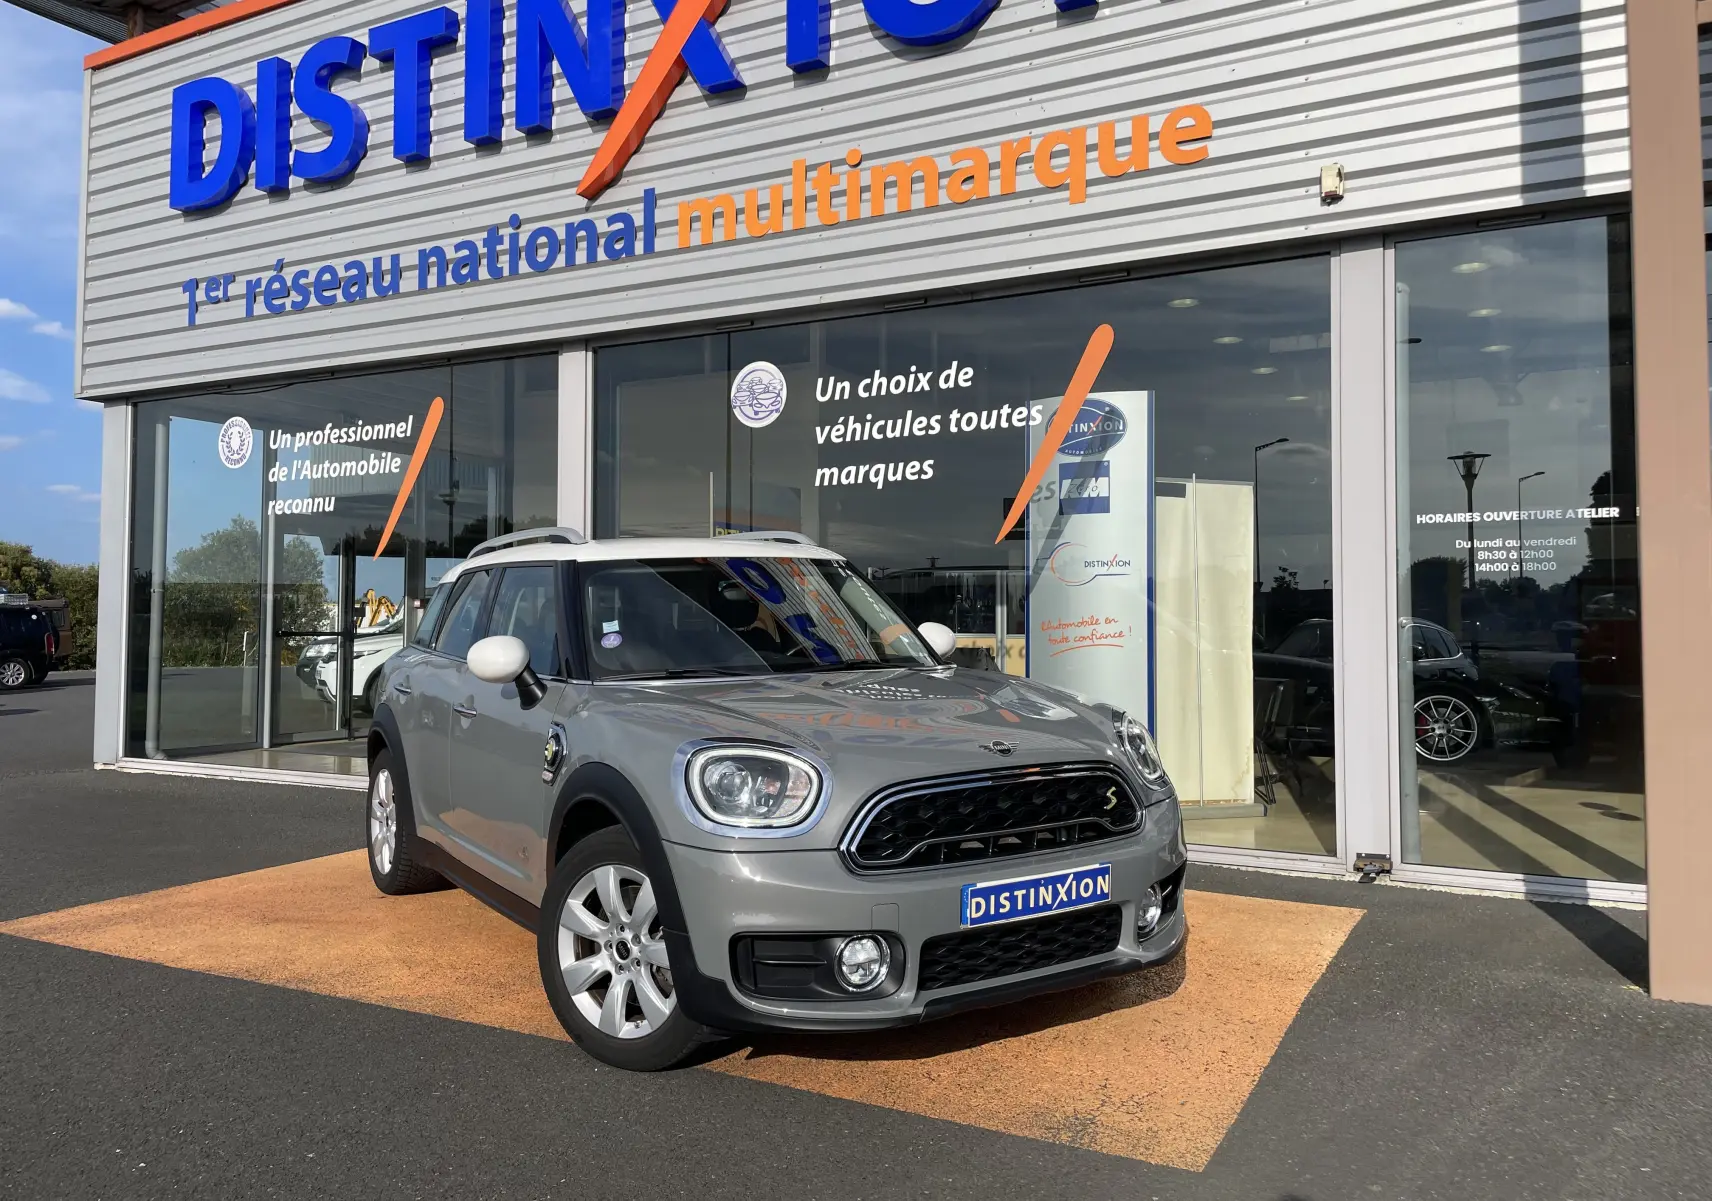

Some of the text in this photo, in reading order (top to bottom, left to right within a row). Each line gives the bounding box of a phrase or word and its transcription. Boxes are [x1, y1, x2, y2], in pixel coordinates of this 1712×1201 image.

[245, 253, 402, 318] réseau
[417, 187, 656, 290] national
[677, 102, 1213, 249] multimarque
[815, 360, 974, 402] Un choix de
[269, 414, 414, 453] Un professionnel
[815, 403, 1043, 444] véhicules toutes
[268, 452, 401, 482] de l'Automobile
[814, 459, 934, 489] marques
[267, 496, 336, 516] reconnu
[1416, 507, 1620, 524] HORAIRES OUVERTURE ATELIER
[1455, 536, 1577, 549] Du lundi au vendredi
[1084, 554, 1131, 571] DISTINXION
[1477, 549, 1554, 560] 8h30 à 12h00
[1474, 562, 1557, 572] 14h00 à 18h00
[1104, 616, 1119, 625] en
[1047, 632, 1071, 645] toute
[1073, 628, 1126, 643] confiance
[970, 873, 1110, 919] DISTINXION
